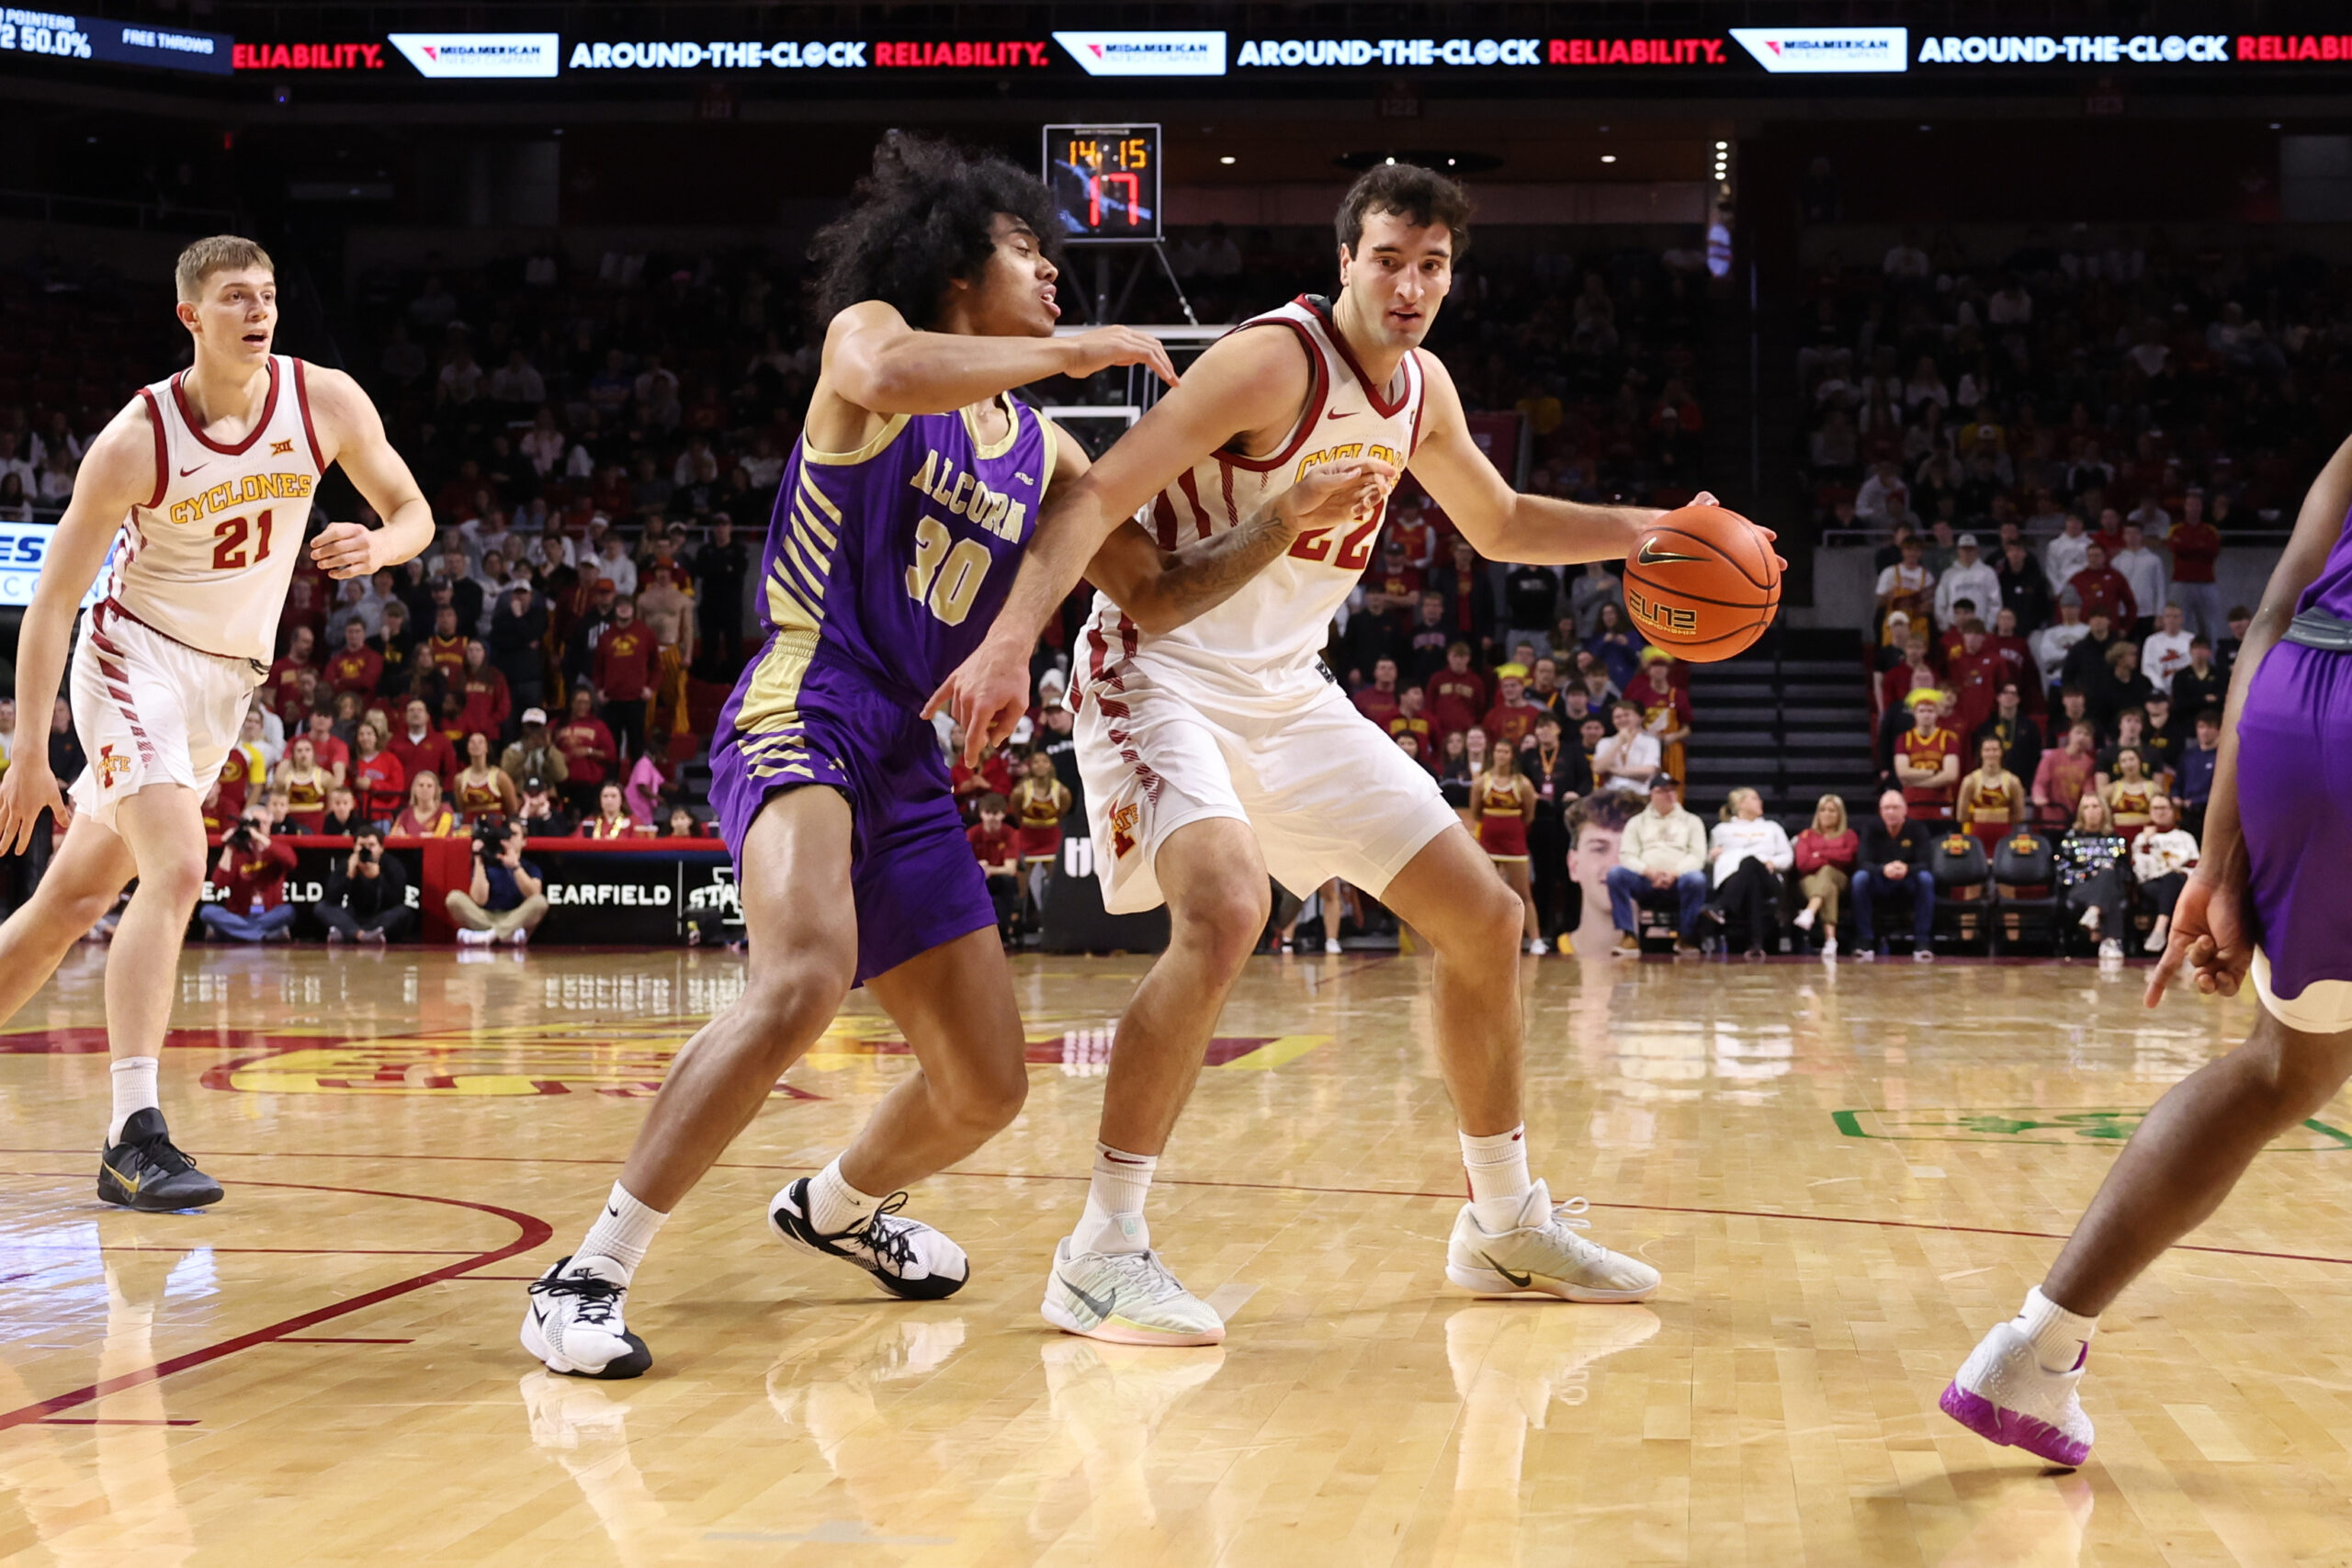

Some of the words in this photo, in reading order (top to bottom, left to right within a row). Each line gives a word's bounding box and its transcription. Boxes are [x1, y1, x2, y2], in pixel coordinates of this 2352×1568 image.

[6, 8, 75, 32] POINTERS
[20, 25, 92, 59] 50.0%
[122, 28, 155, 47] FREE
[158, 33, 214, 54] THROWS
[569, 41, 867, 69] AROUND-THE-CLOCK
[875, 42, 1049, 67] RELIABILITY.
[1237, 39, 1541, 66] AROUND-THE-CLOCK
[1548, 39, 1726, 65] RELIABILITY.
[1917, 35, 2229, 63] AROUND-THE-CLOCK
[2236, 35, 2352, 62] RELIABI
[232, 43, 385, 69] ELIABILITY.
[1090, 172, 1138, 227] 17
[170, 472, 312, 525] CYCLONES
[910, 448, 1027, 545] ALCORN
[212, 509, 273, 570] 21
[904, 514, 993, 627] 30
[547, 884, 672, 906] EARFIELD
[689, 883, 739, 912] STA
